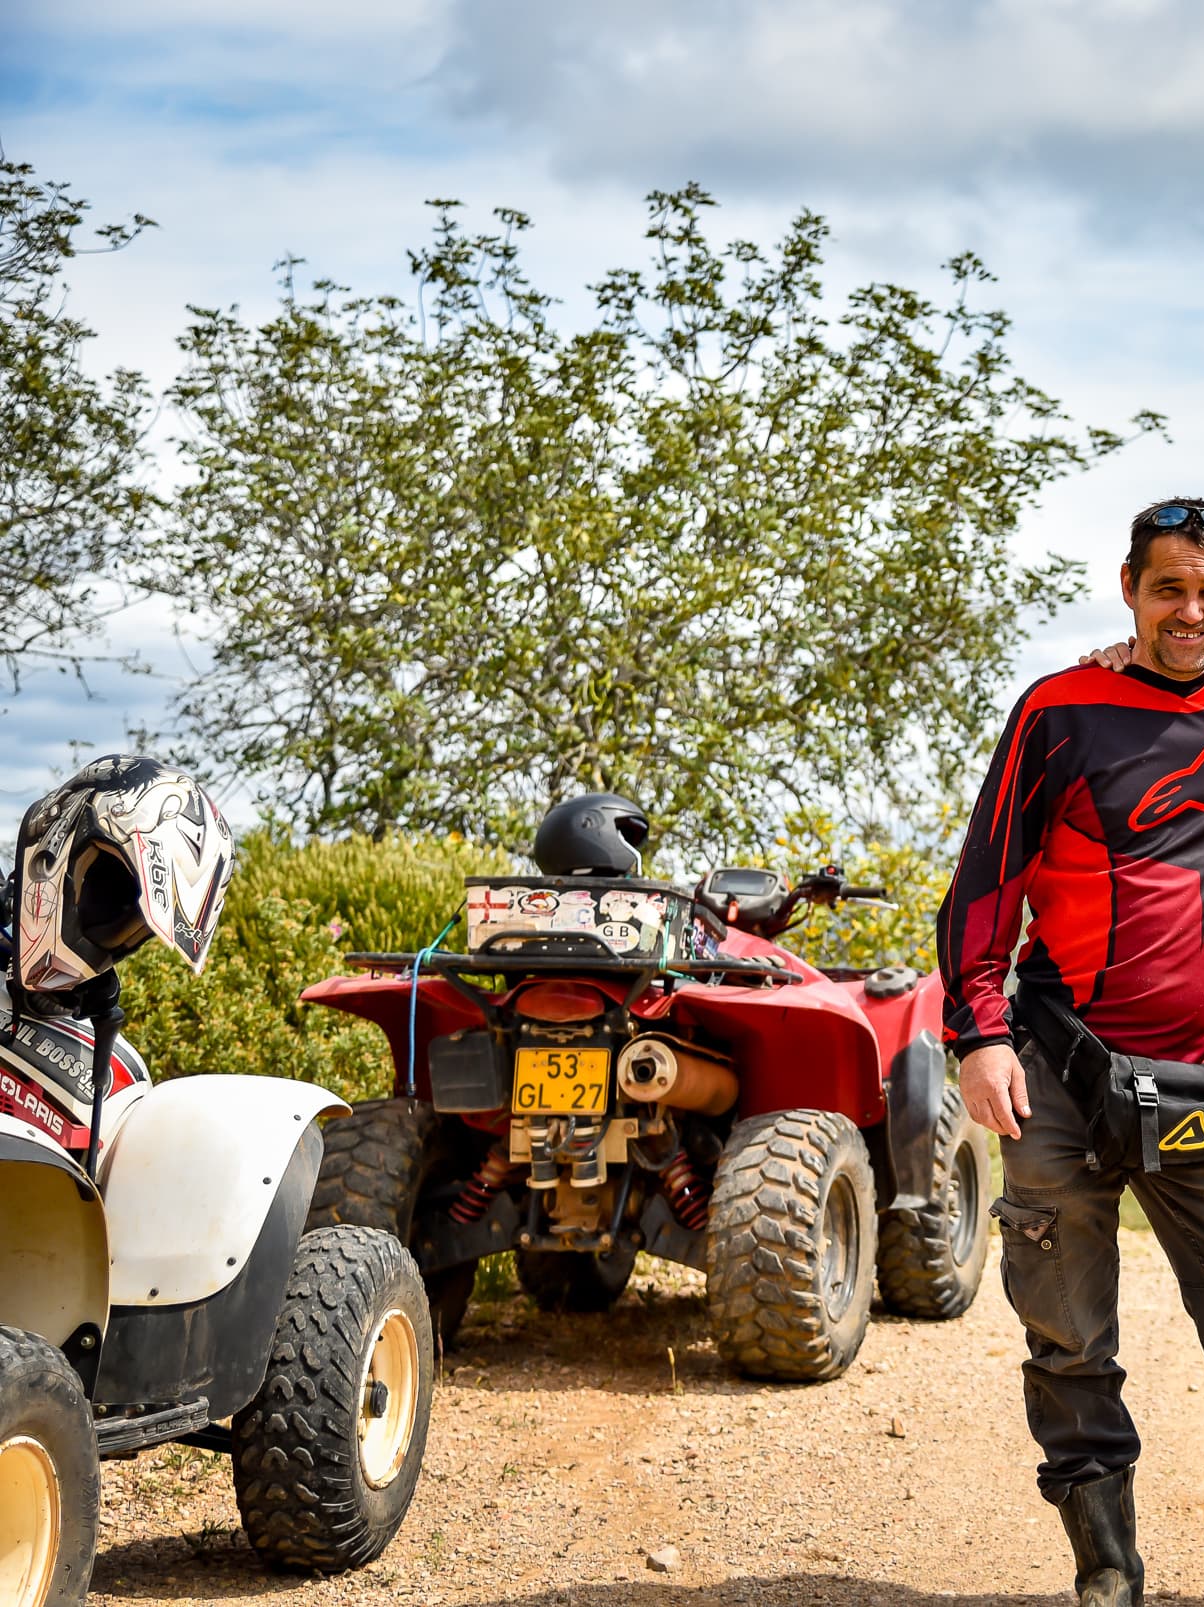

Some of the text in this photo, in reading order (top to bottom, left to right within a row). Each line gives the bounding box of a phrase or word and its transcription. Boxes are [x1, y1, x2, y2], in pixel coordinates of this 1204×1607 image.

[35, 1037, 85, 1078] BOSS
[547, 1054, 578, 1079] 53
[0, 1072, 64, 1137] OLARIS
[518, 1083, 603, 1109] GL 27
